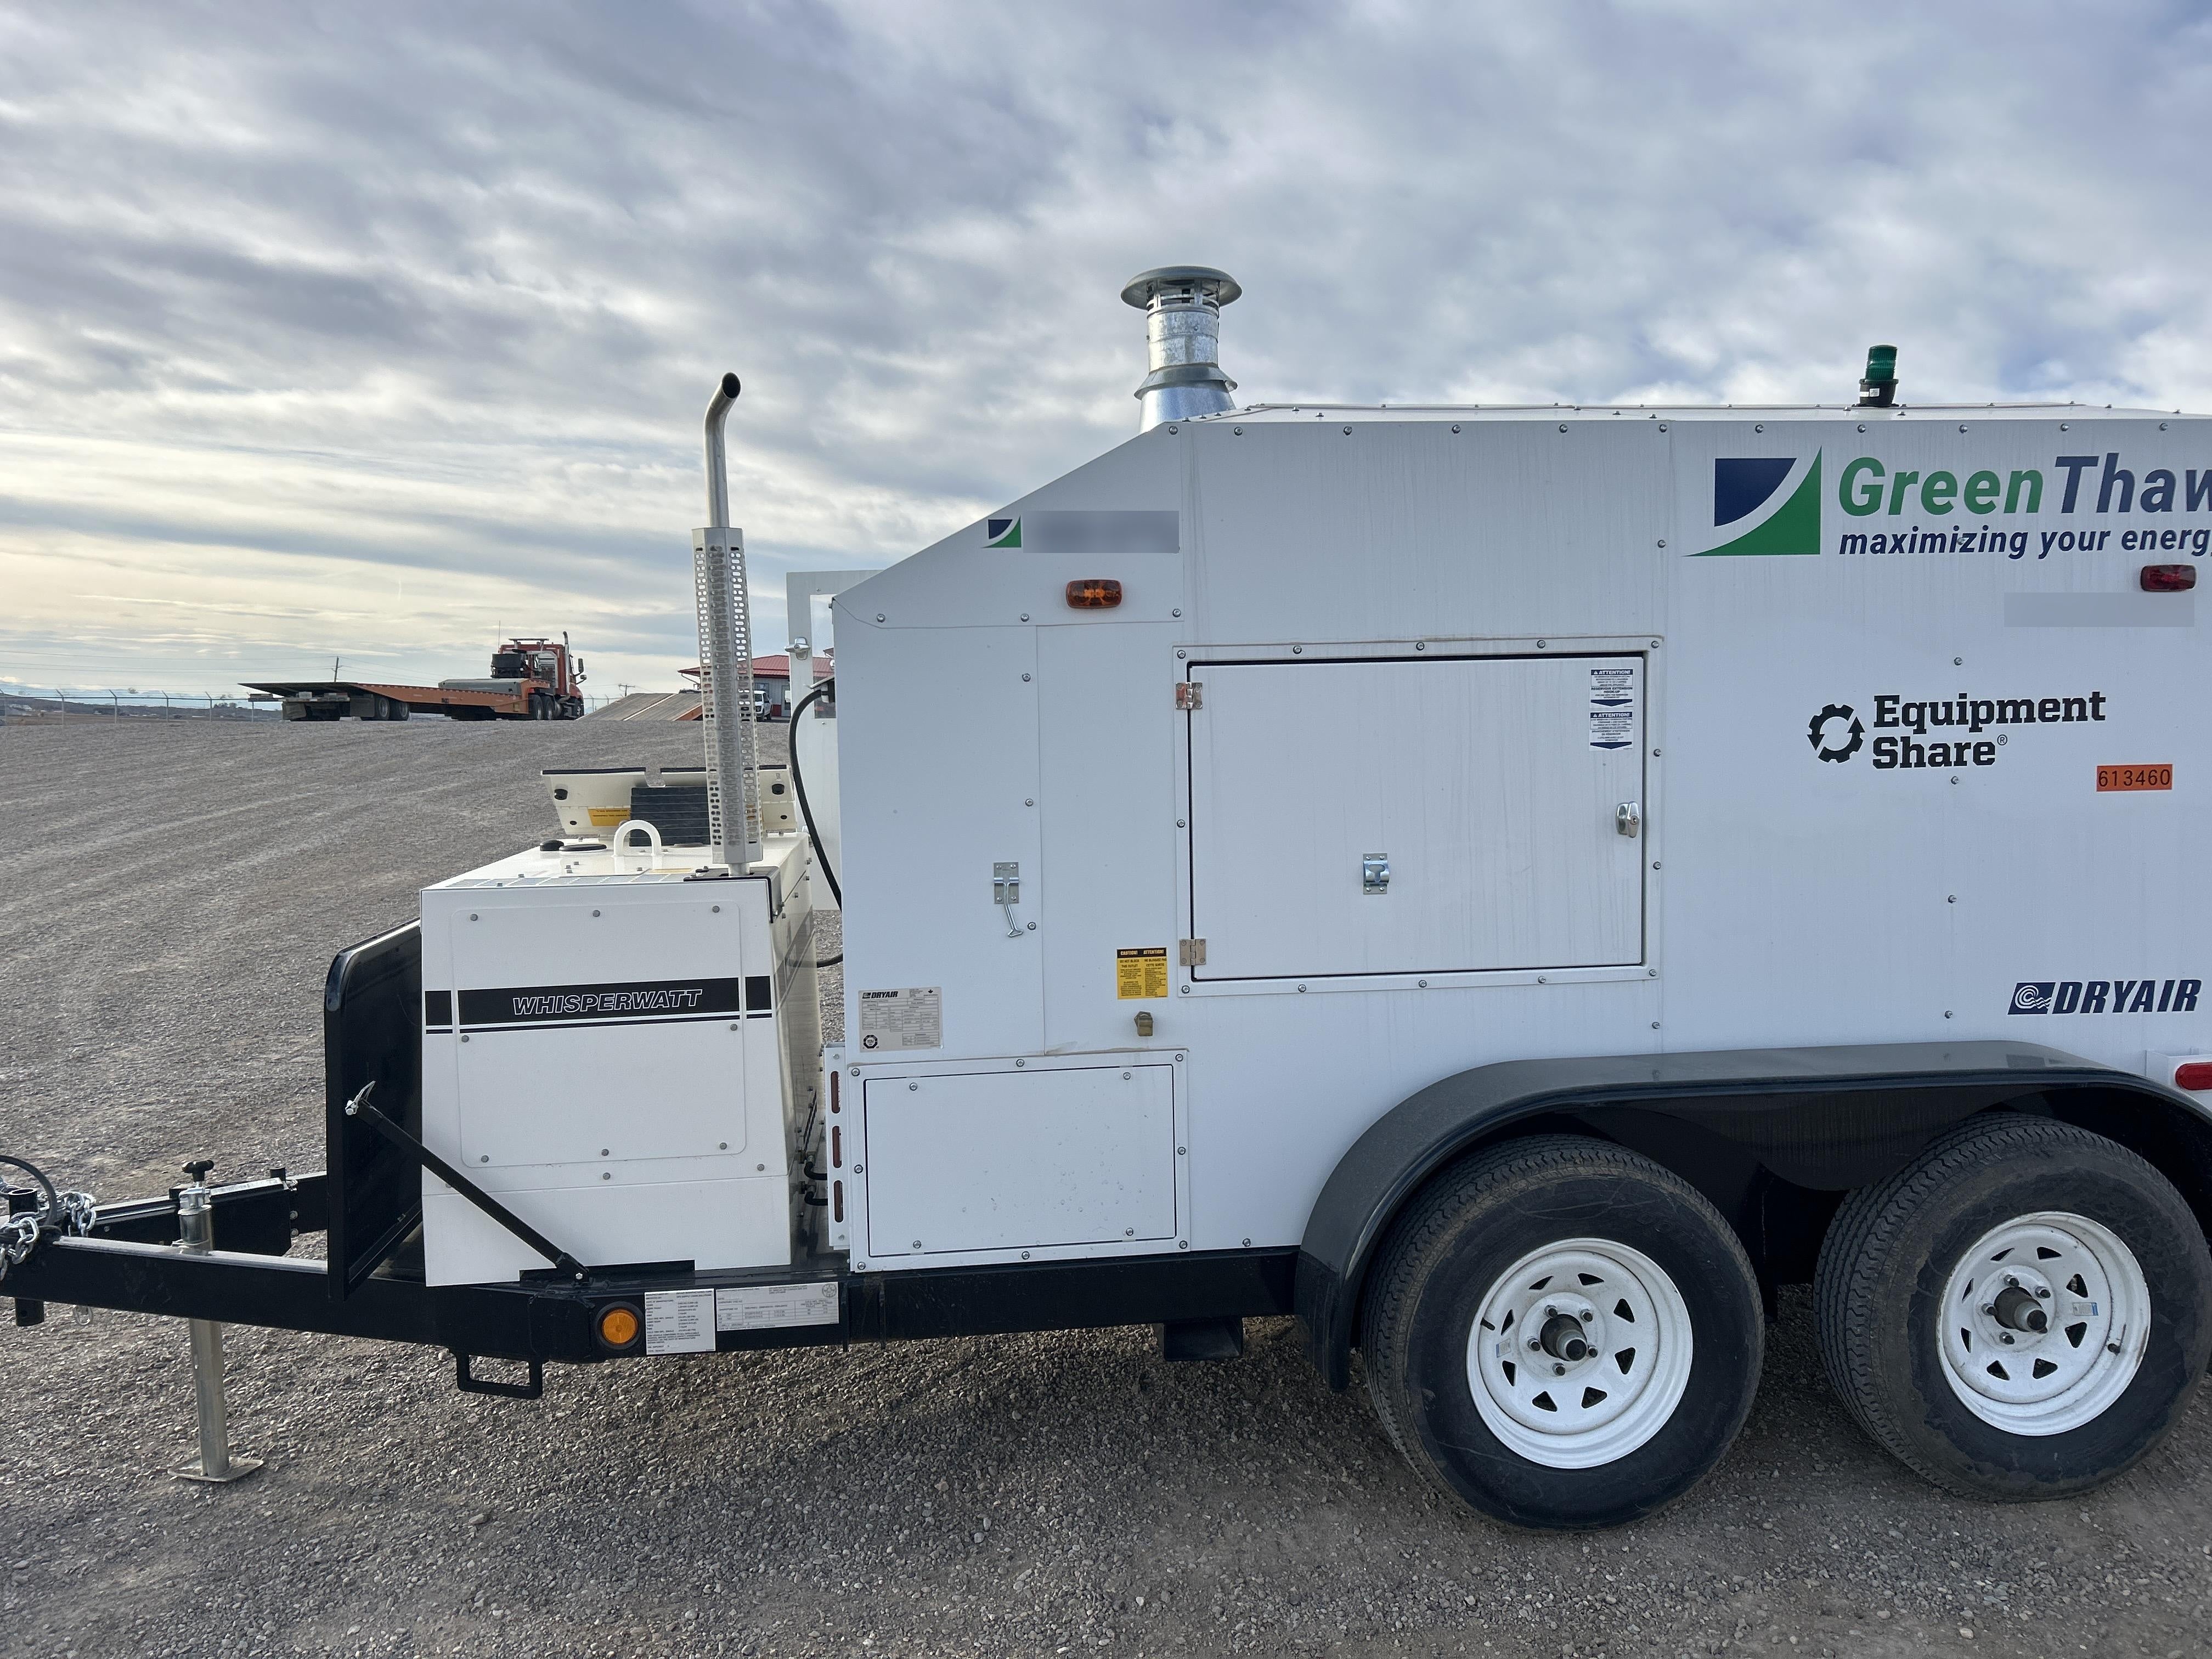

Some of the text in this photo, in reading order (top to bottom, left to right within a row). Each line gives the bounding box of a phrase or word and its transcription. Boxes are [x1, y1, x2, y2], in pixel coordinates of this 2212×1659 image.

[1839, 524, 2212, 560] maximizing your energ
[1873, 691, 2106, 733] Equipment
[2098, 769, 2170, 787] 613460
[512, 989, 702, 1015] WHISPERWATT
[2051, 979, 2202, 1014] DRYAIR
